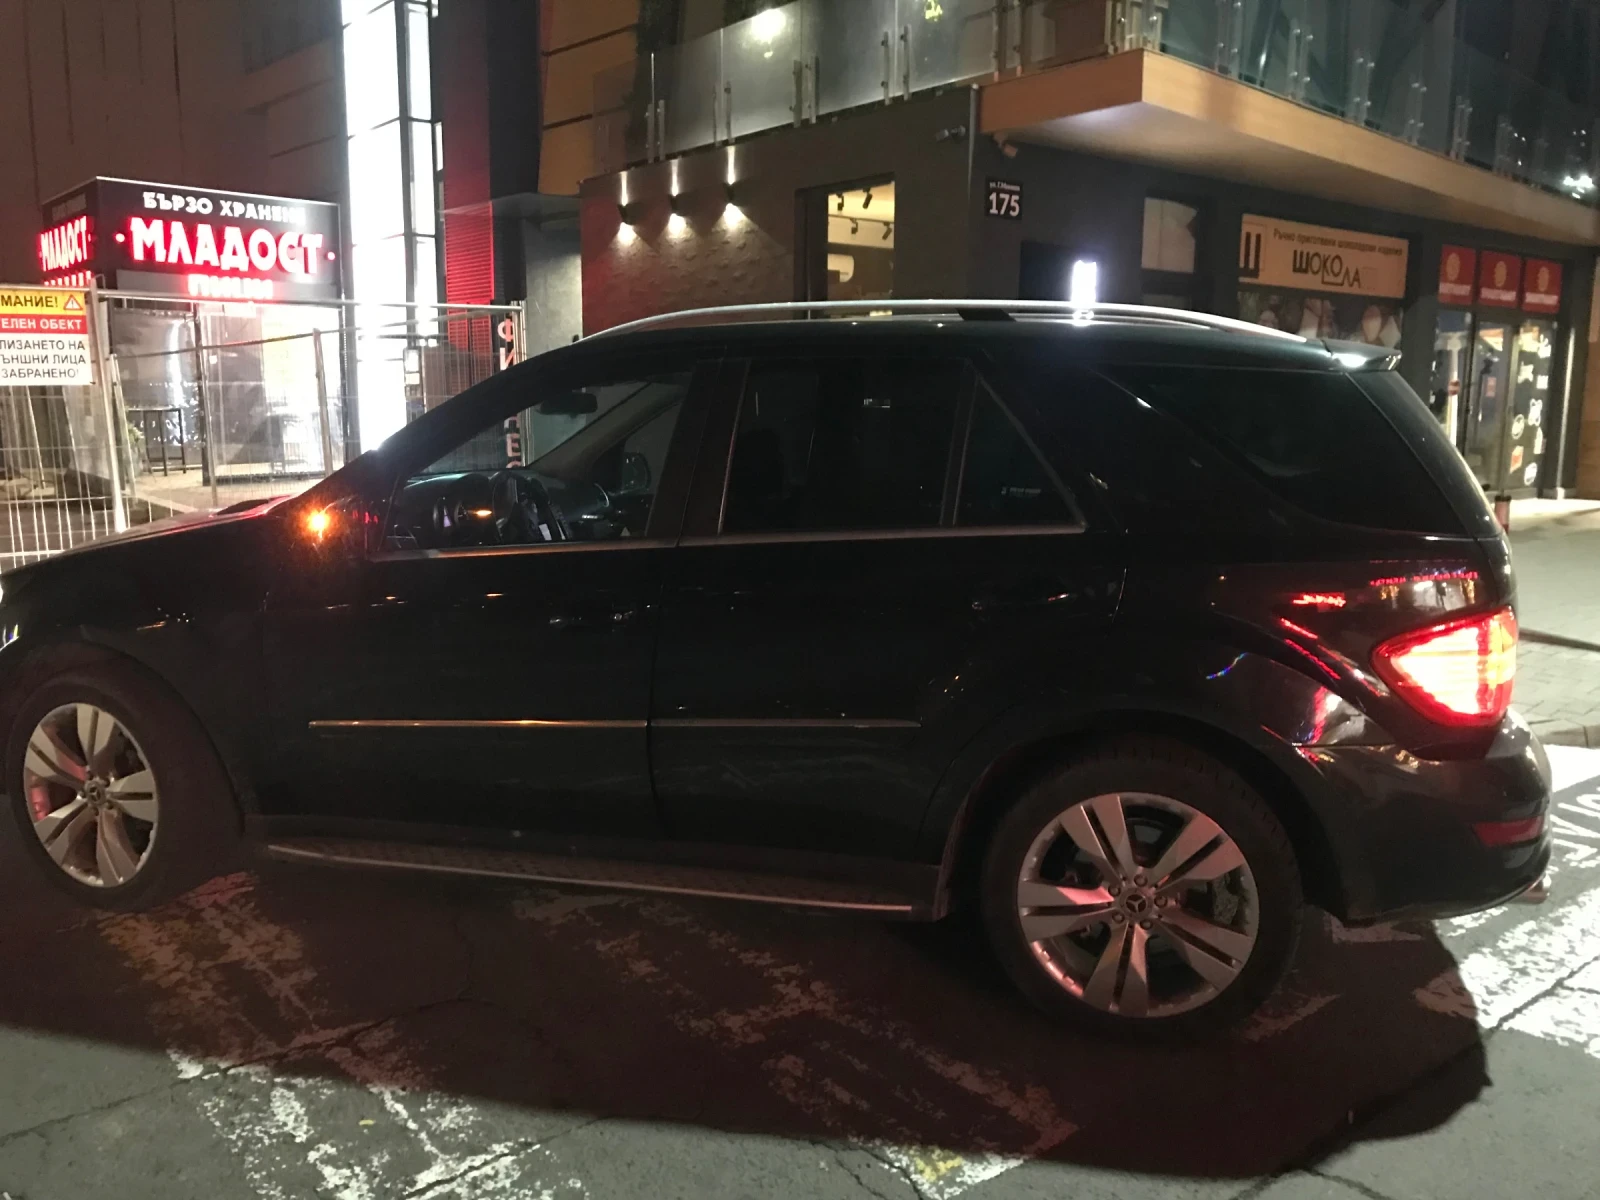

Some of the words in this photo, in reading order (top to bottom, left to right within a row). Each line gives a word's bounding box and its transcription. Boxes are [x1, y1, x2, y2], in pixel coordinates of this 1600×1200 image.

[143, 191, 213, 215] БЪРЗО
[989, 191, 1020, 217] 175
[129, 217, 324, 275] МЛАДОСТ
[1292, 249, 1362, 290] ШОКОЛА
[1, 294, 59, 308] МАНИЕ!
[1, 317, 37, 330] ЕЛЕН
[40, 318, 83, 330] ОБЕКТ
[68, 340, 86, 351] НА
[53, 354, 87, 366] ЛИЦА
[2, 367, 79, 379] ЗАБРАНЕНО!
